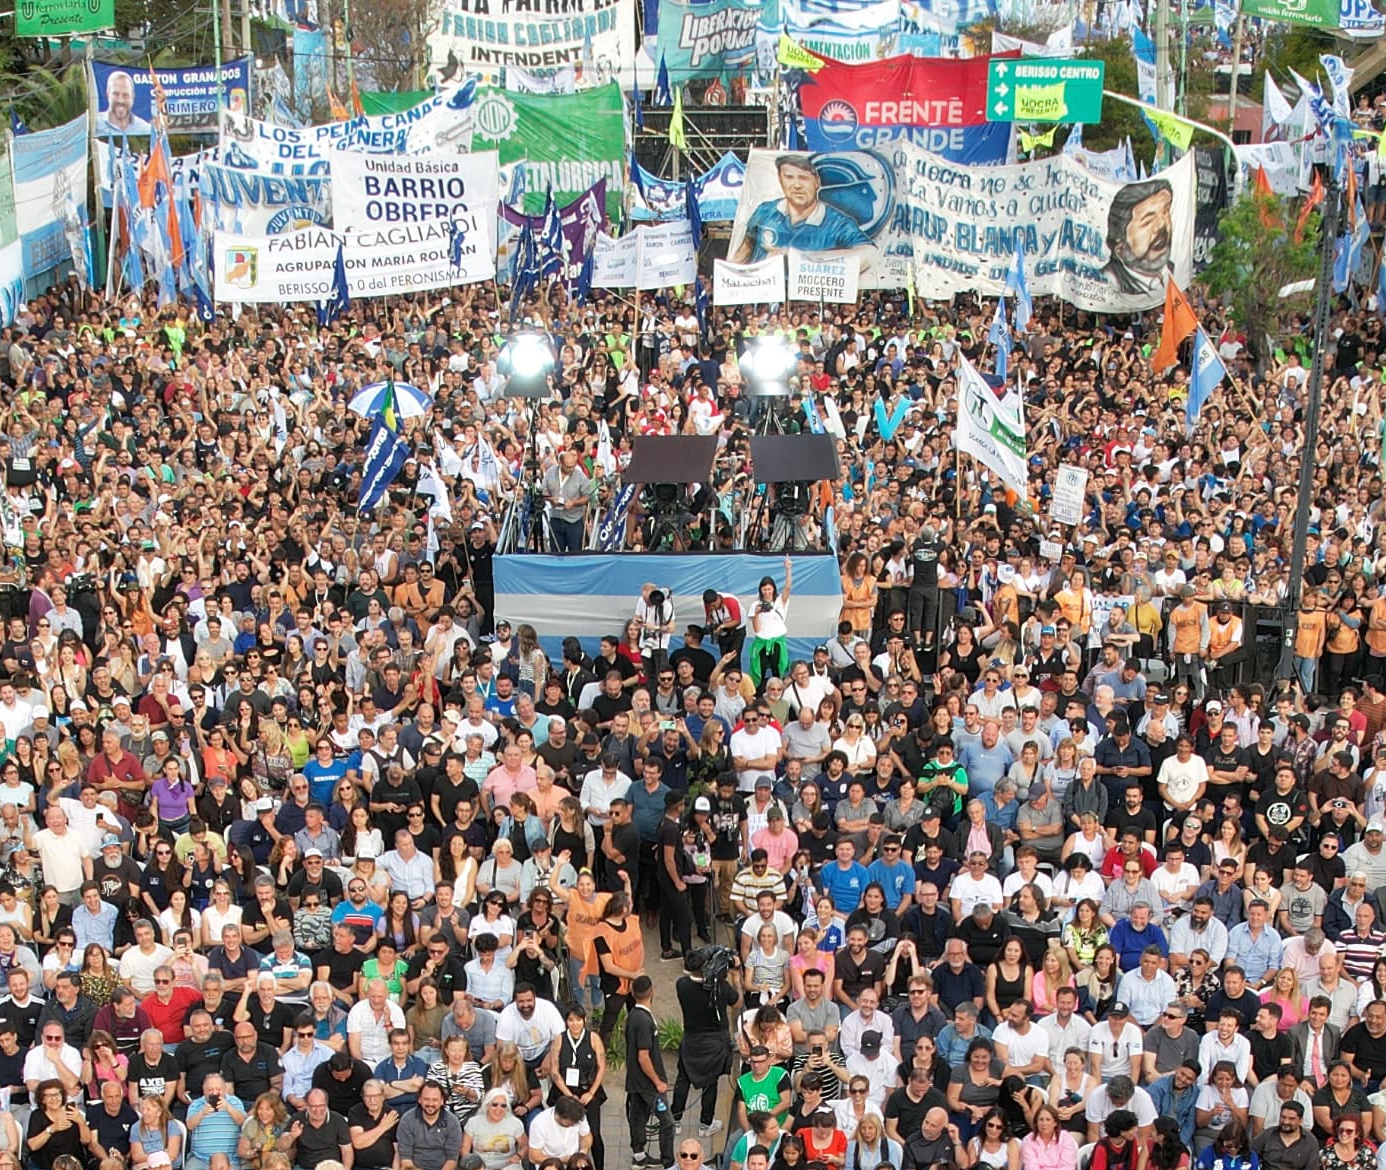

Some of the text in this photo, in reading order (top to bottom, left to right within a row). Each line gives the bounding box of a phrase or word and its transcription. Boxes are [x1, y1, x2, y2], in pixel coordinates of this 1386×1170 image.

[471, 46, 583, 66] INTENDENT
[1015, 66, 1100, 79] BERISSO CENTRO
[866, 99, 963, 124] FRENTE
[259, 125, 301, 143] LOS
[856, 128, 963, 150] GRANDE
[366, 160, 459, 173] Unidad Básica
[524, 156, 623, 193] ETALÚRGICA
[365, 175, 465, 199] BARRIO
[269, 233, 346, 252] FABIAN
[955, 221, 1039, 257] BLANCA
[372, 254, 416, 269] MARIA
[278, 282, 329, 296] BERISSO
[369, 276, 388, 290] del
[798, 275, 846, 288] MOCCERO
[797, 287, 845, 298] PRESENTE
